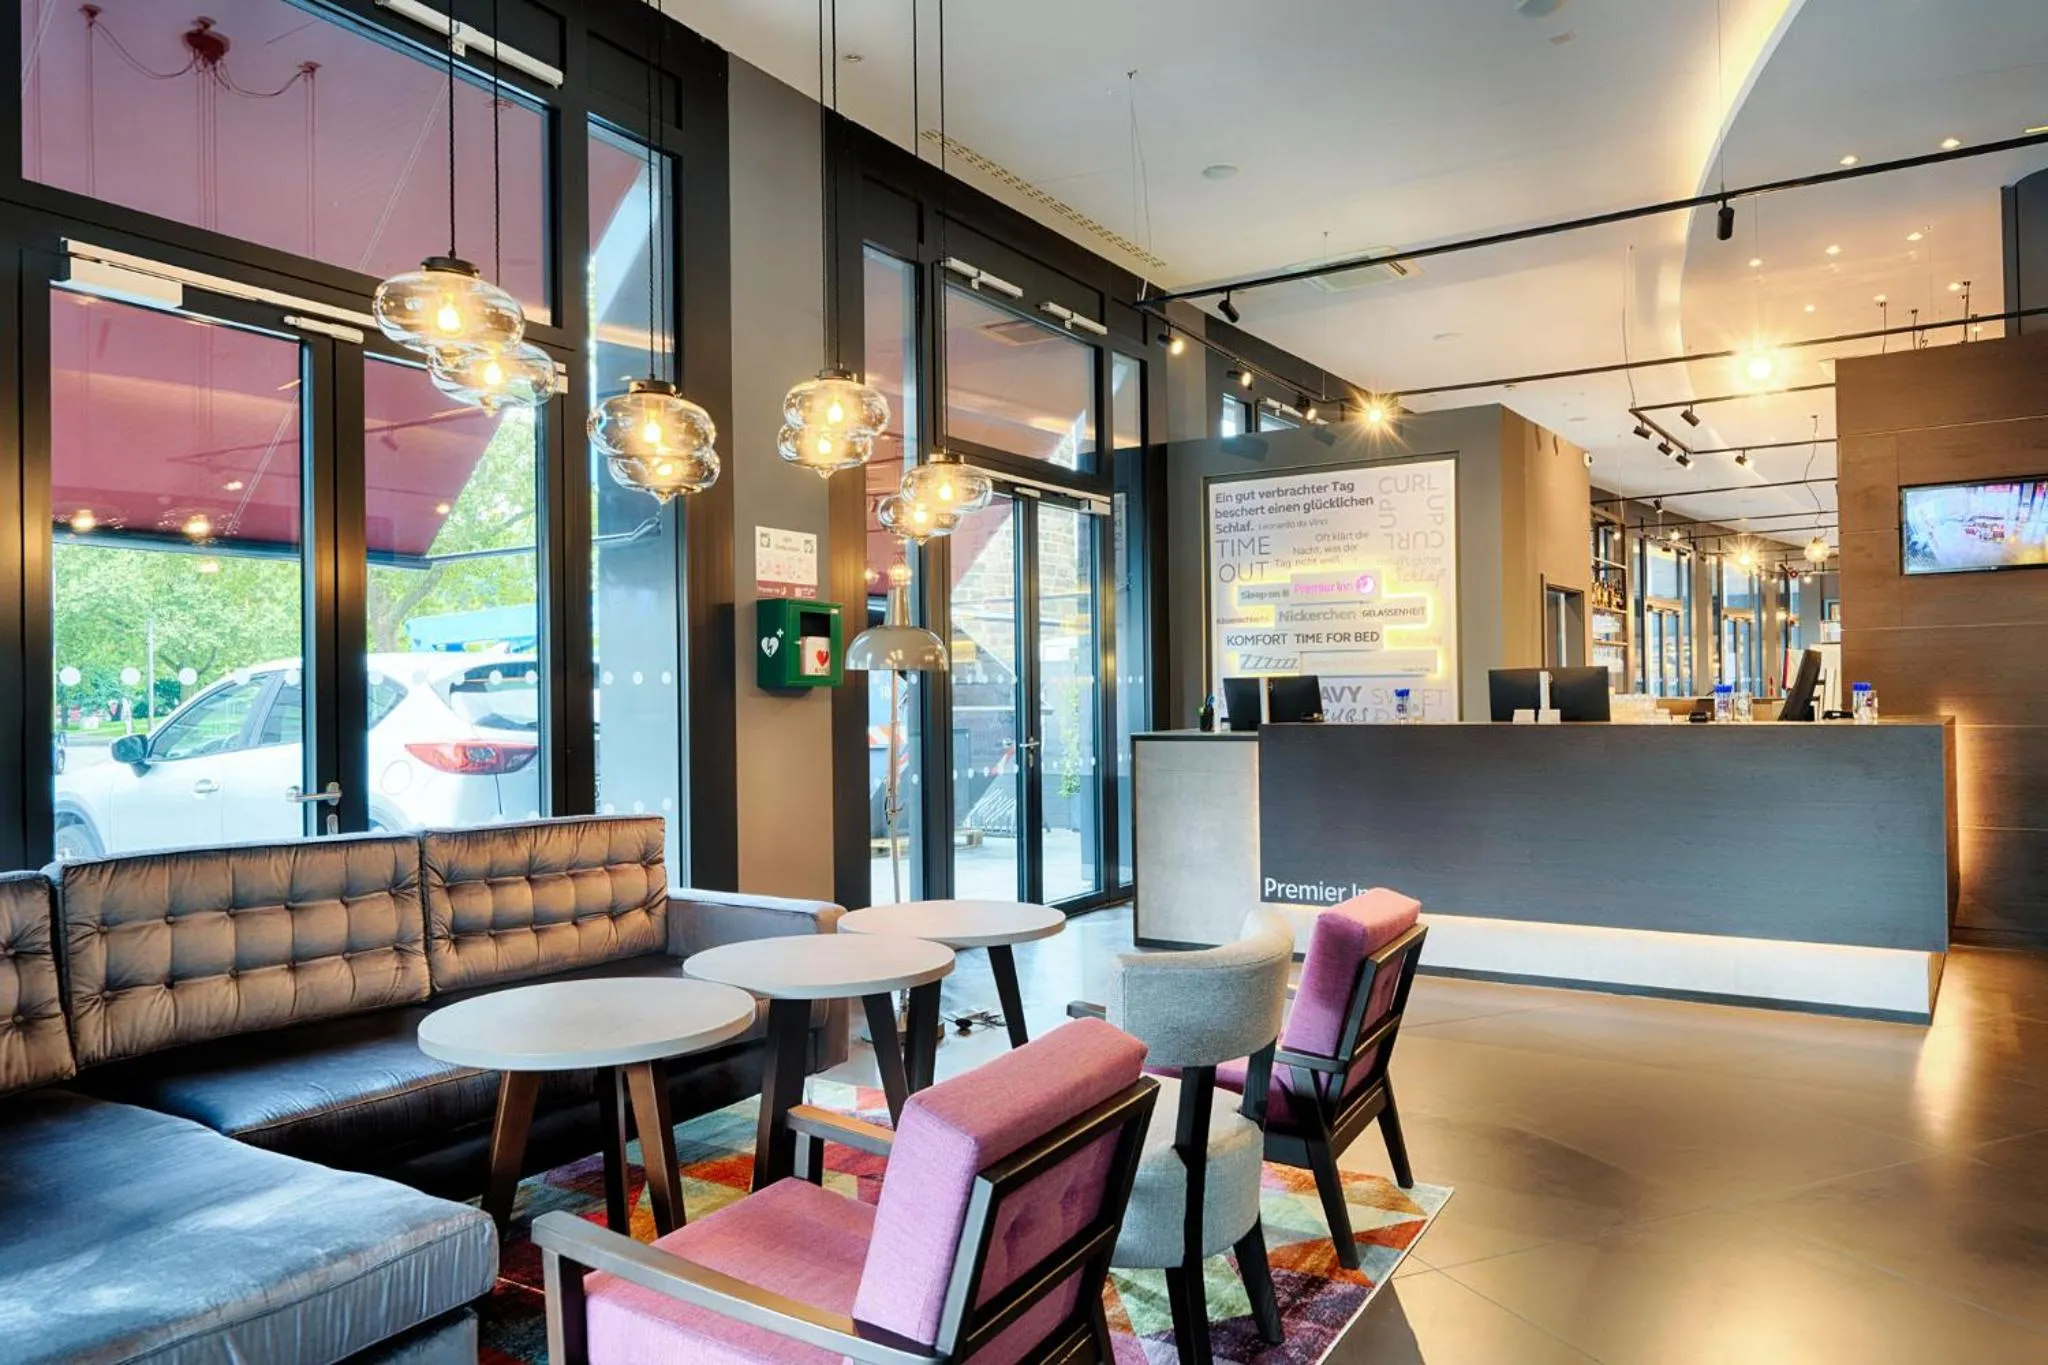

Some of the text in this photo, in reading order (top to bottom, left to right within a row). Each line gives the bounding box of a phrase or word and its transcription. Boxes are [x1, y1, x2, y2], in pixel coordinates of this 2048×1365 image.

[1215, 481, 1355, 505] Ein gut verbrachter Tag
[1378, 473, 1439, 495] CURL
[1215, 495, 1374, 519] beschert einen glücklichen
[1215, 521, 1254, 535] Schlaf.
[1215, 536, 1271, 558] TIME
[1218, 561, 1269, 584] OUT
[1226, 633, 1287, 647] KOMFORT
[1295, 632, 1323, 644] TIME
[1326, 631, 1352, 644] FOR
[1354, 631, 1380, 643] BED
[1320, 685, 1362, 703] AVY
[1264, 877, 1347, 902] Premier
